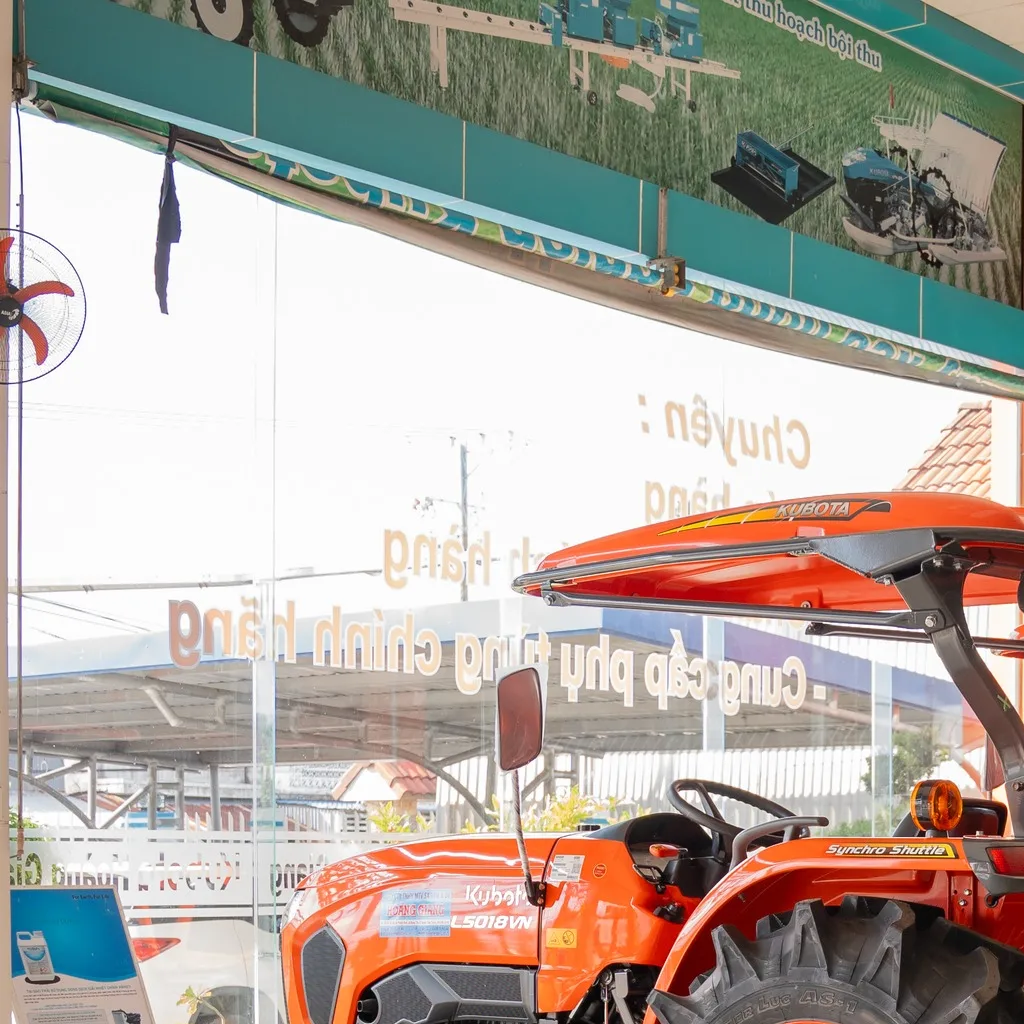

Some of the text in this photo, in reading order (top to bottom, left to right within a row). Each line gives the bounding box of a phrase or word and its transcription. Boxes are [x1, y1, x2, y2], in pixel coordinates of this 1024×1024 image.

[777, 3, 824, 42] hoạch
[829, 26, 853, 58] bội
[857, 43, 881, 68] thu
[775, 501, 851, 518] KUBOTA
[826, 844, 946, 856] Synchro Shuttle
[466, 884, 534, 907] Kubot
[450, 915, 533, 930] L5018VN
[798, 988, 859, 1015] AS-1
